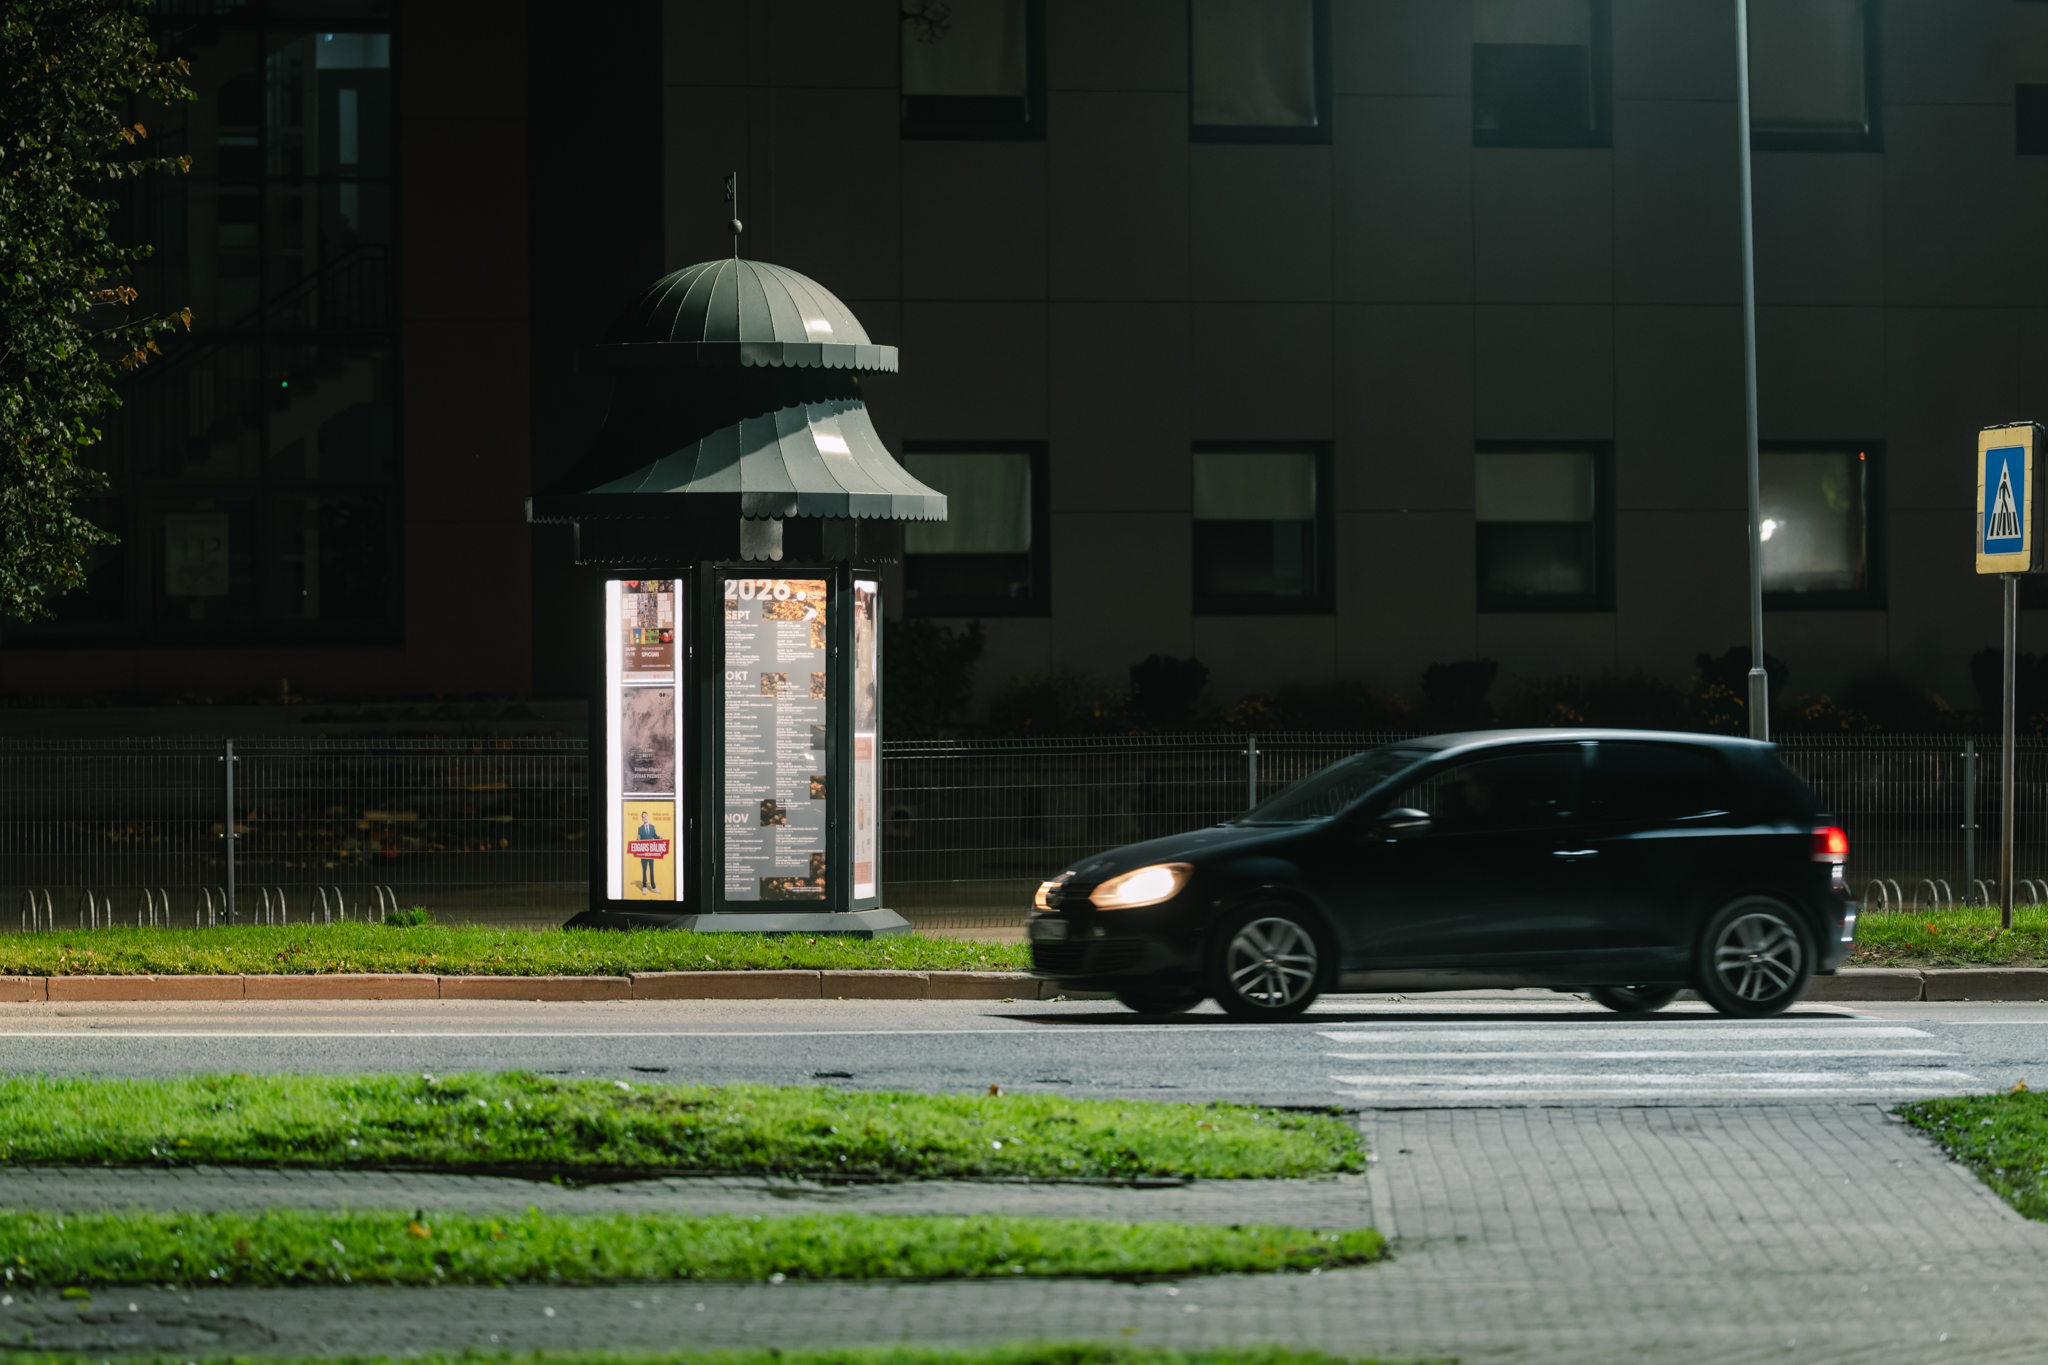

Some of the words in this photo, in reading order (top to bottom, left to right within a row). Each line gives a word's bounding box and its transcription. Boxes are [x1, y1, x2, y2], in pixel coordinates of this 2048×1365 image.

[725, 579, 790, 600] 2026
[725, 611, 750, 620] SEPT
[725, 671, 748, 680] OKT
[725, 813, 749, 823] NOV
[631, 843, 649, 852] EDGARS
